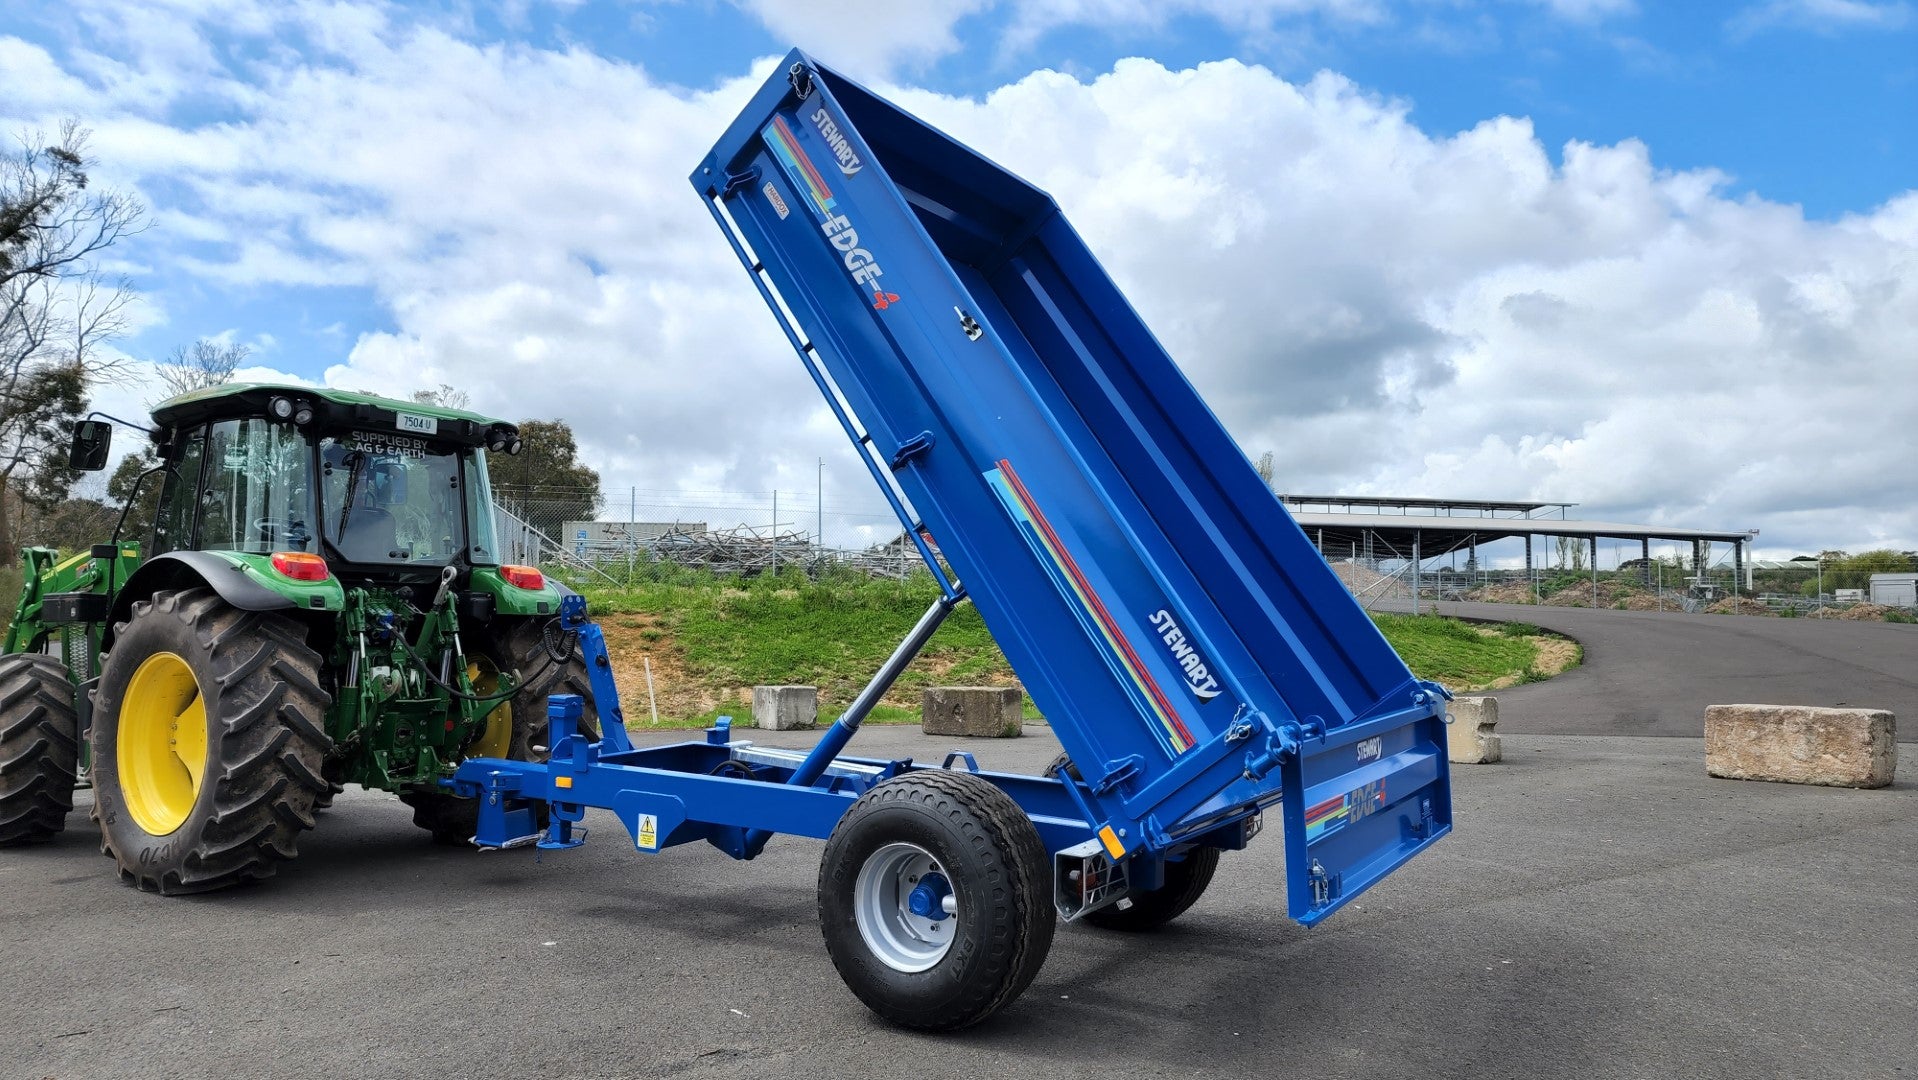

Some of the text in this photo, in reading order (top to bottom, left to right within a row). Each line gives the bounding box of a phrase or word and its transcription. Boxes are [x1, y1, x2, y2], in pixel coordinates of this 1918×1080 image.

[767, 187, 787, 213] HARDOX
[404, 416, 423, 428] 7504
[352, 430, 428, 449] SUPPLIED BY
[355, 442, 425, 459] AG & EARTH
[952, 937, 974, 980] BKT
